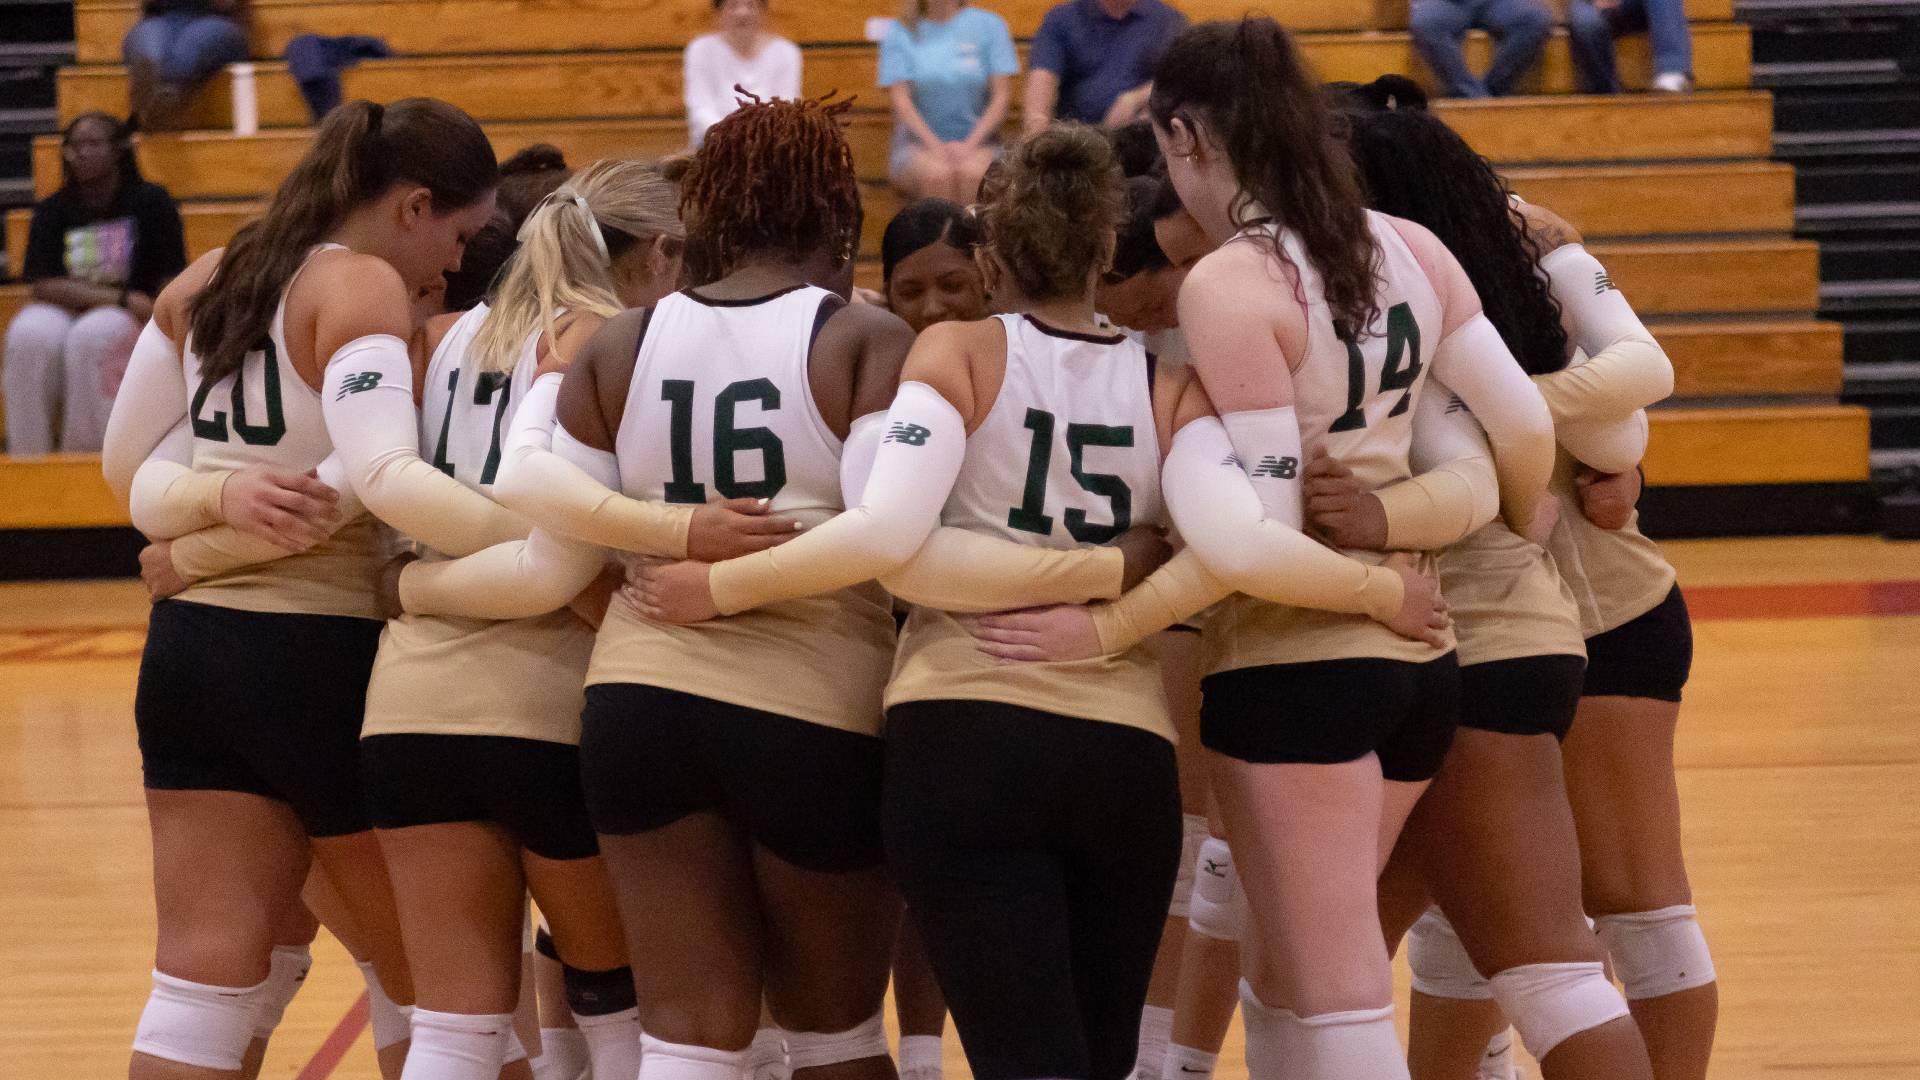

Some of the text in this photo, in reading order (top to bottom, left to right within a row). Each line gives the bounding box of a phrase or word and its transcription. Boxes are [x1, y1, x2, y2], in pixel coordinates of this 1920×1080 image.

[434, 368, 513, 484] 17
[1328, 301, 1423, 433] 14
[661, 377, 787, 504] 16
[1007, 407, 1135, 544] 15
